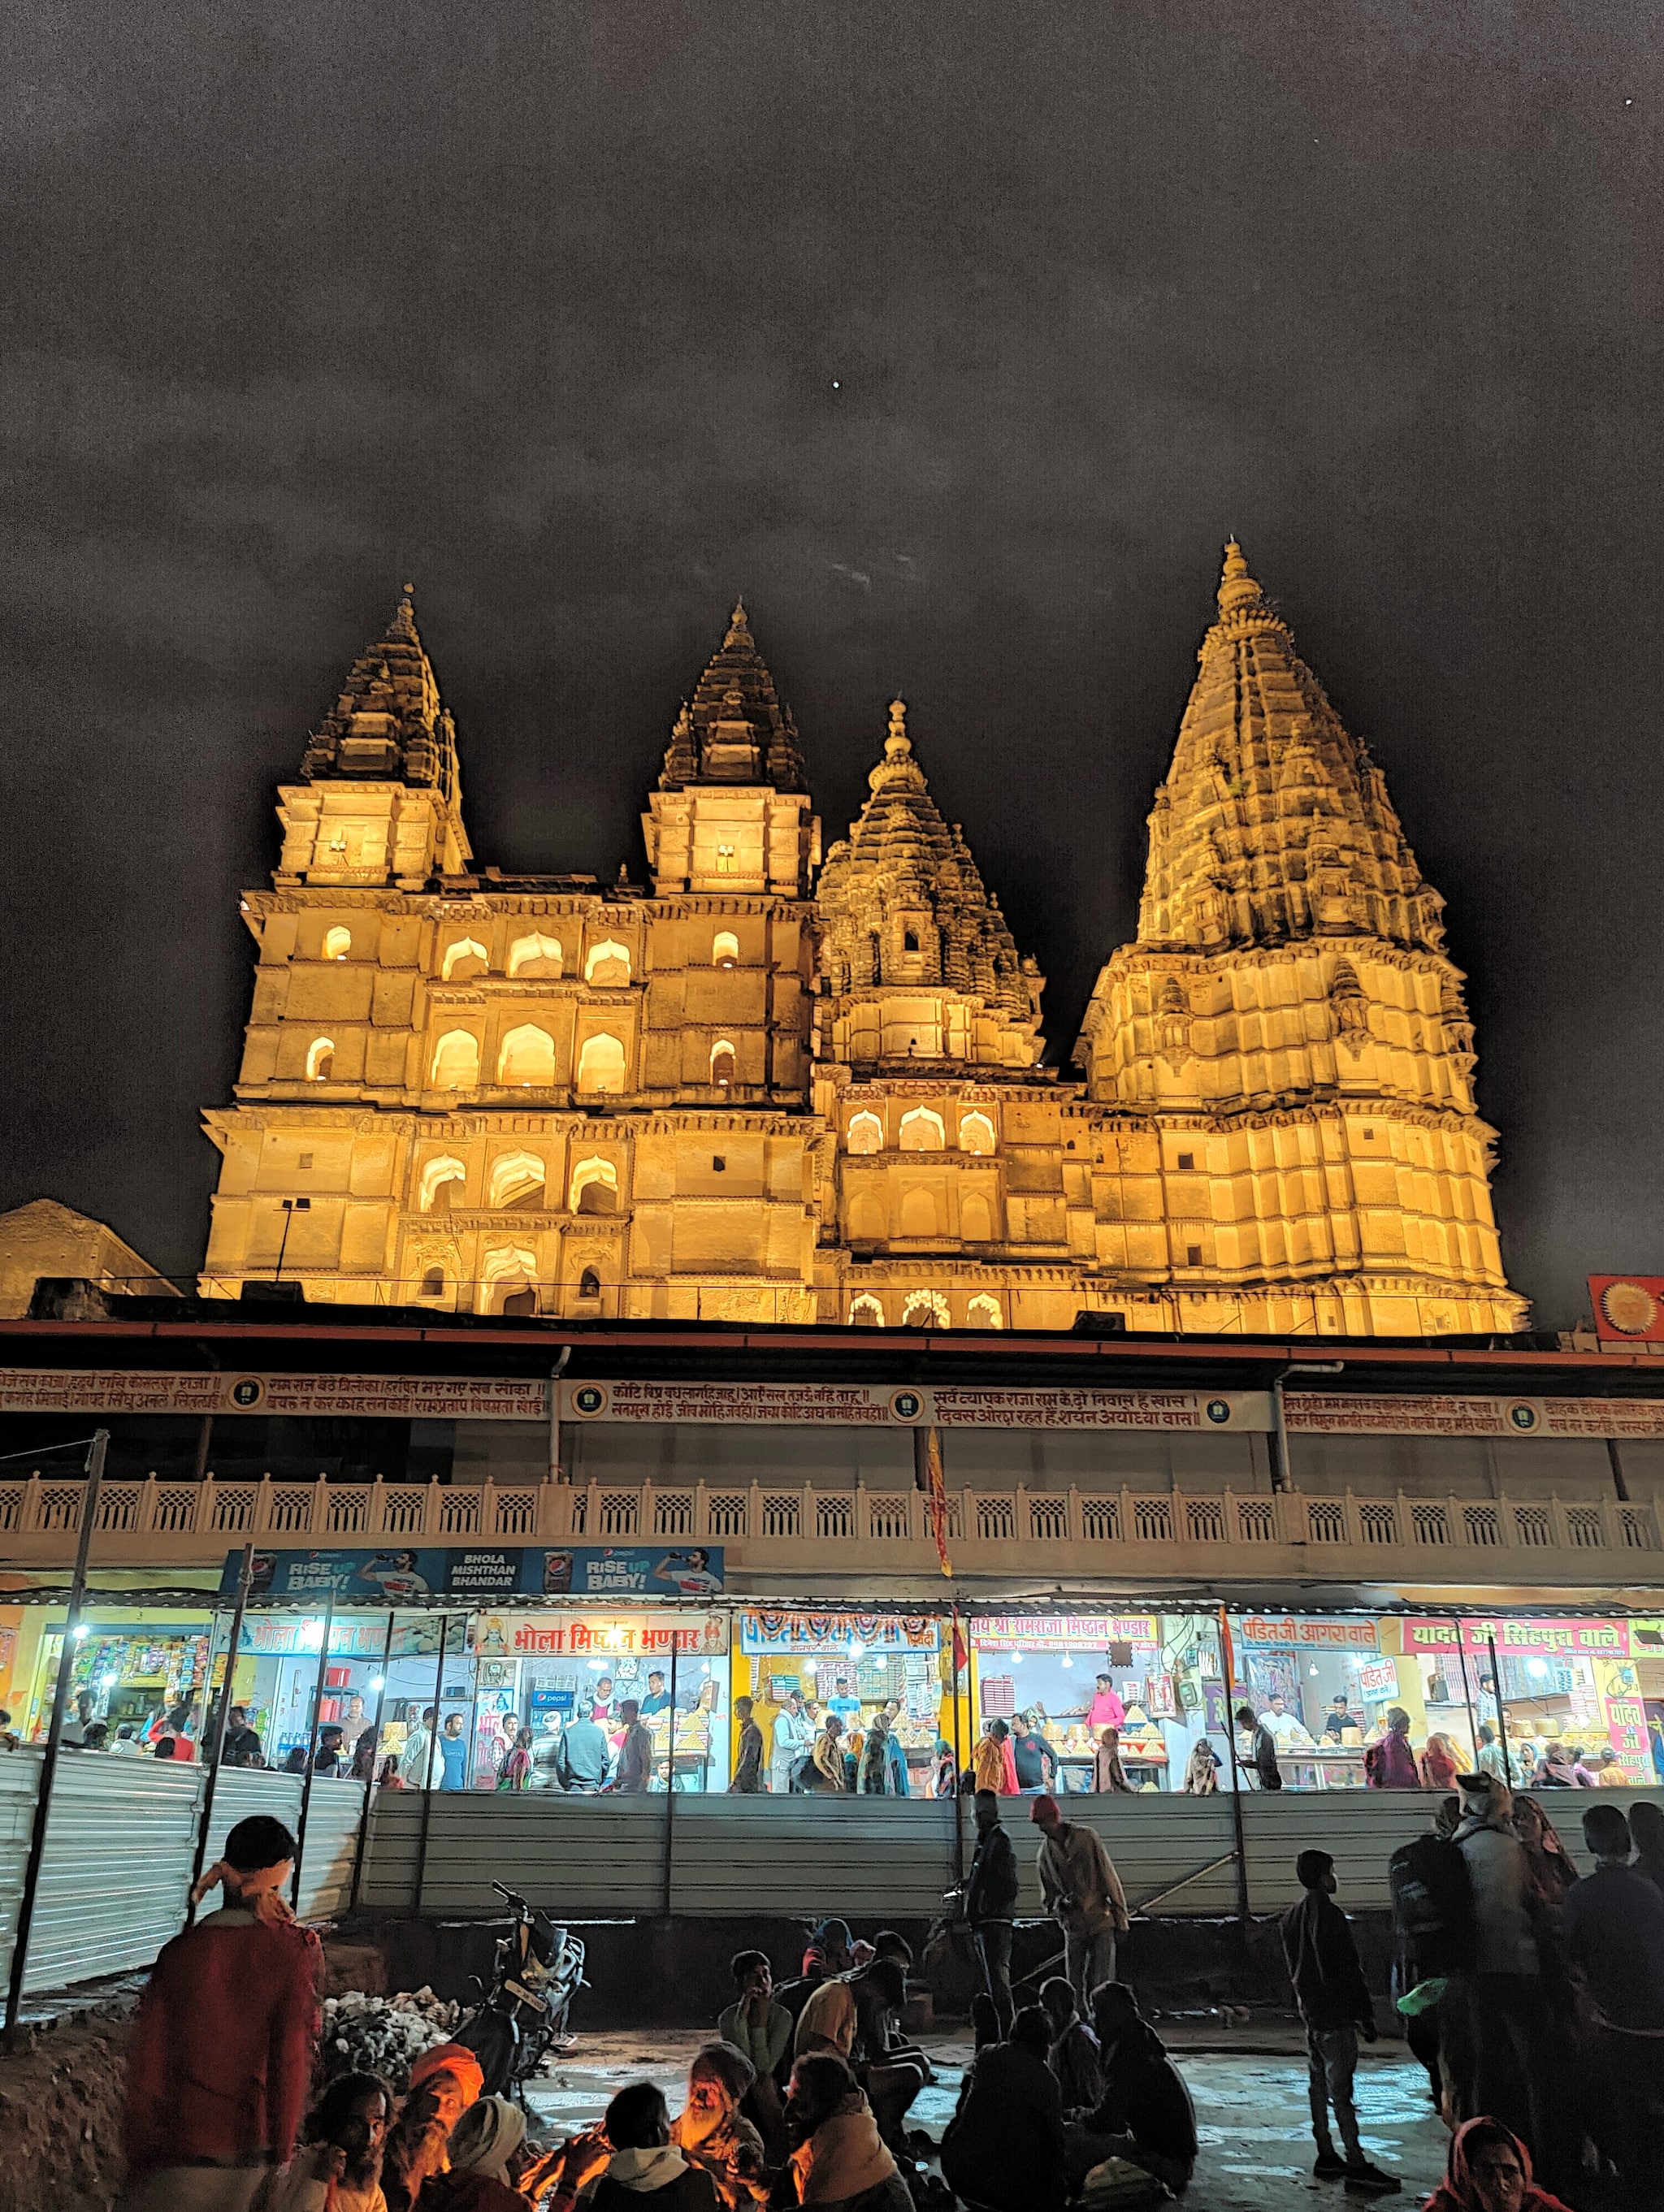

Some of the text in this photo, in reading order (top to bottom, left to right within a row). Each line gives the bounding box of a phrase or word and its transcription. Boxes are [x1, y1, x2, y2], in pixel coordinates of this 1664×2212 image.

[464, 1553, 505, 1564] BHOLA
[451, 1565, 516, 1576] MISHTHAN
[287, 1574, 350, 1591] BABY!
[452, 1576, 513, 1587] BHANDAR
[587, 1572, 648, 1591] BABY!
[254, 1619, 298, 1651] भोला
[993, 1616, 1010, 1635] श्री
[1013, 1617, 1063, 1636] रामराजा
[1300, 1624, 1346, 1642] आगरा
[1347, 1620, 1376, 1643] वाले
[514, 1623, 566, 1652] भोला
[1412, 1626, 1465, 1644] यादव
[1470, 1621, 1498, 1645] जी
[1503, 1621, 1575, 1653] सिंहपुरा
[1579, 1623, 1621, 1648] वाले
[1382, 1660, 1397, 1683] जी
[548, 1695, 567, 1703] pepsi
[1609, 1703, 1643, 1727] यादव
